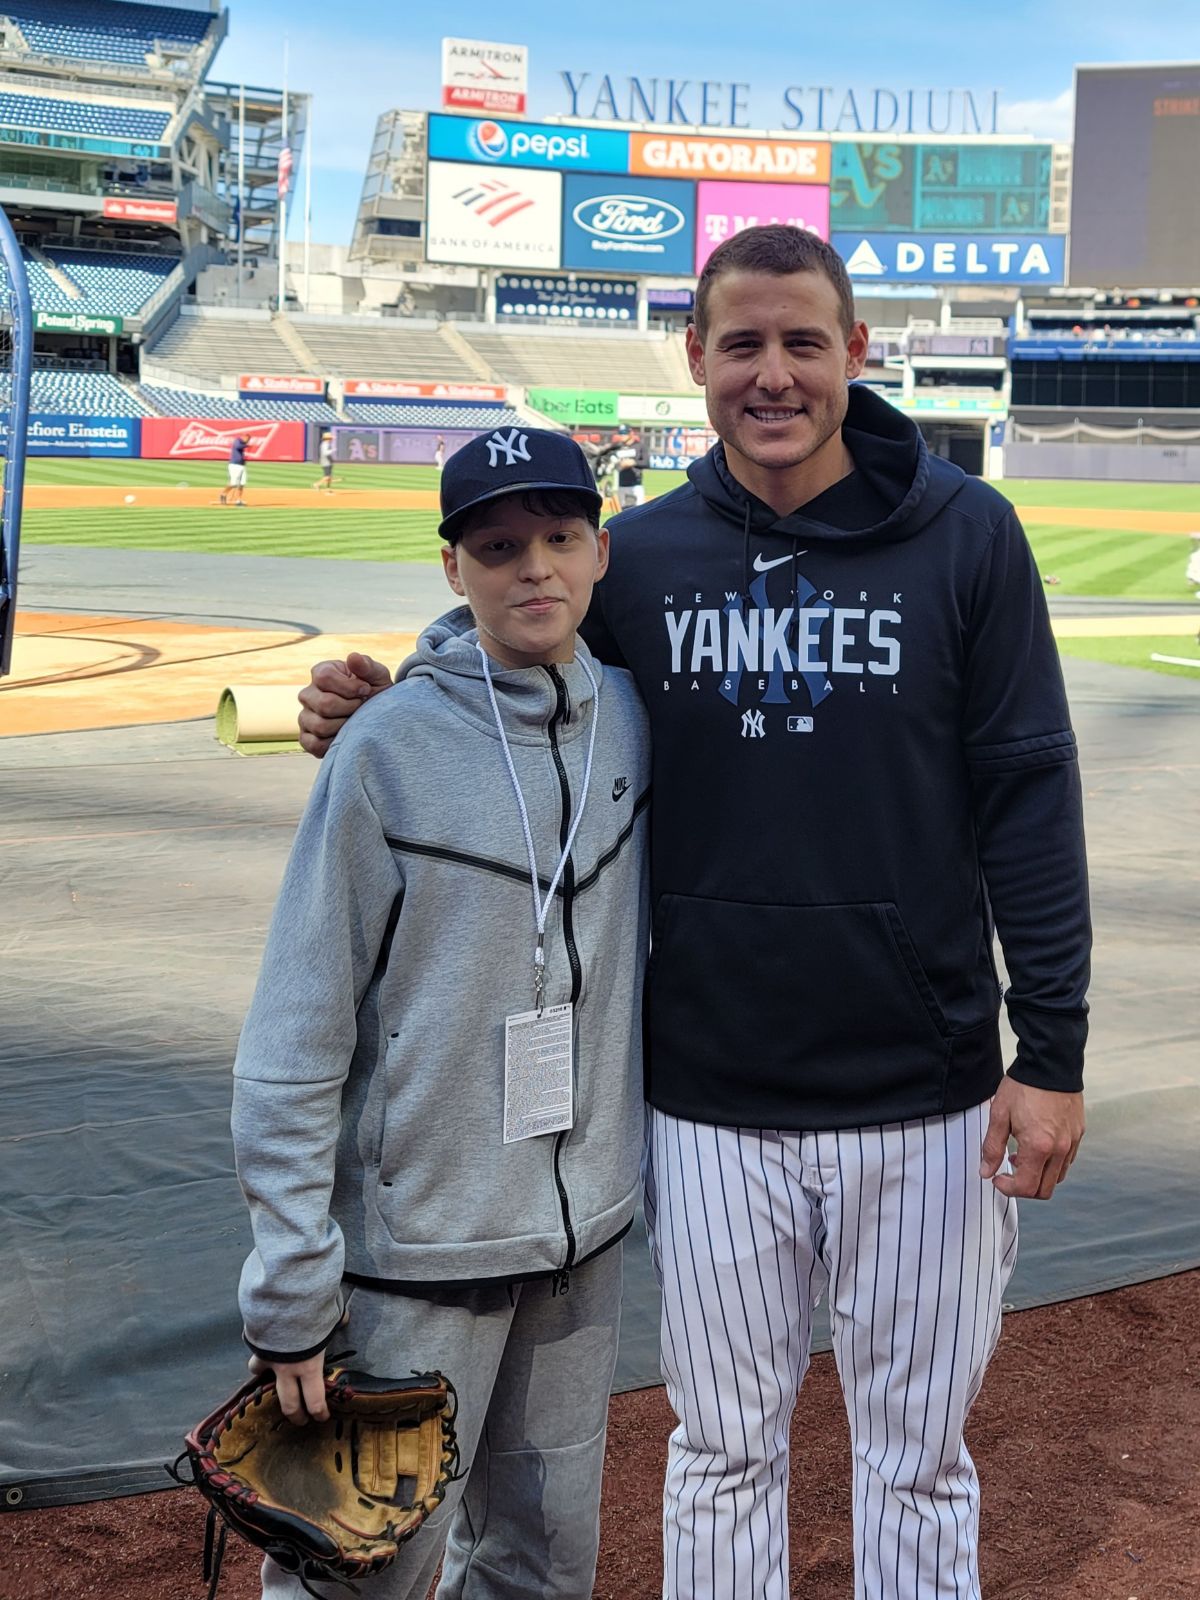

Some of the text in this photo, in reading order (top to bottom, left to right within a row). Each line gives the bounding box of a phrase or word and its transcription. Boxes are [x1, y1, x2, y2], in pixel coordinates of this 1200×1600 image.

[449, 46, 522, 62] ARMITRON
[560, 71, 999, 136] YANKEE STADIUM
[511, 133, 588, 160] pepsi
[642, 140, 818, 176] GATORADE
[592, 199, 666, 233] Ford
[430, 236, 555, 253] BANK OF AMERICA
[896, 242, 1051, 275] DELTA
[37, 312, 115, 334] Poland Spring
[575, 399, 614, 415] Eats
[69, 422, 128, 439] Einstein
[485, 428, 532, 468] NY
[664, 590, 902, 604] NEW ORK
[664, 607, 902, 675] YANKEES
[663, 679, 899, 694] BASEBALL
[741, 709, 766, 738] NY
